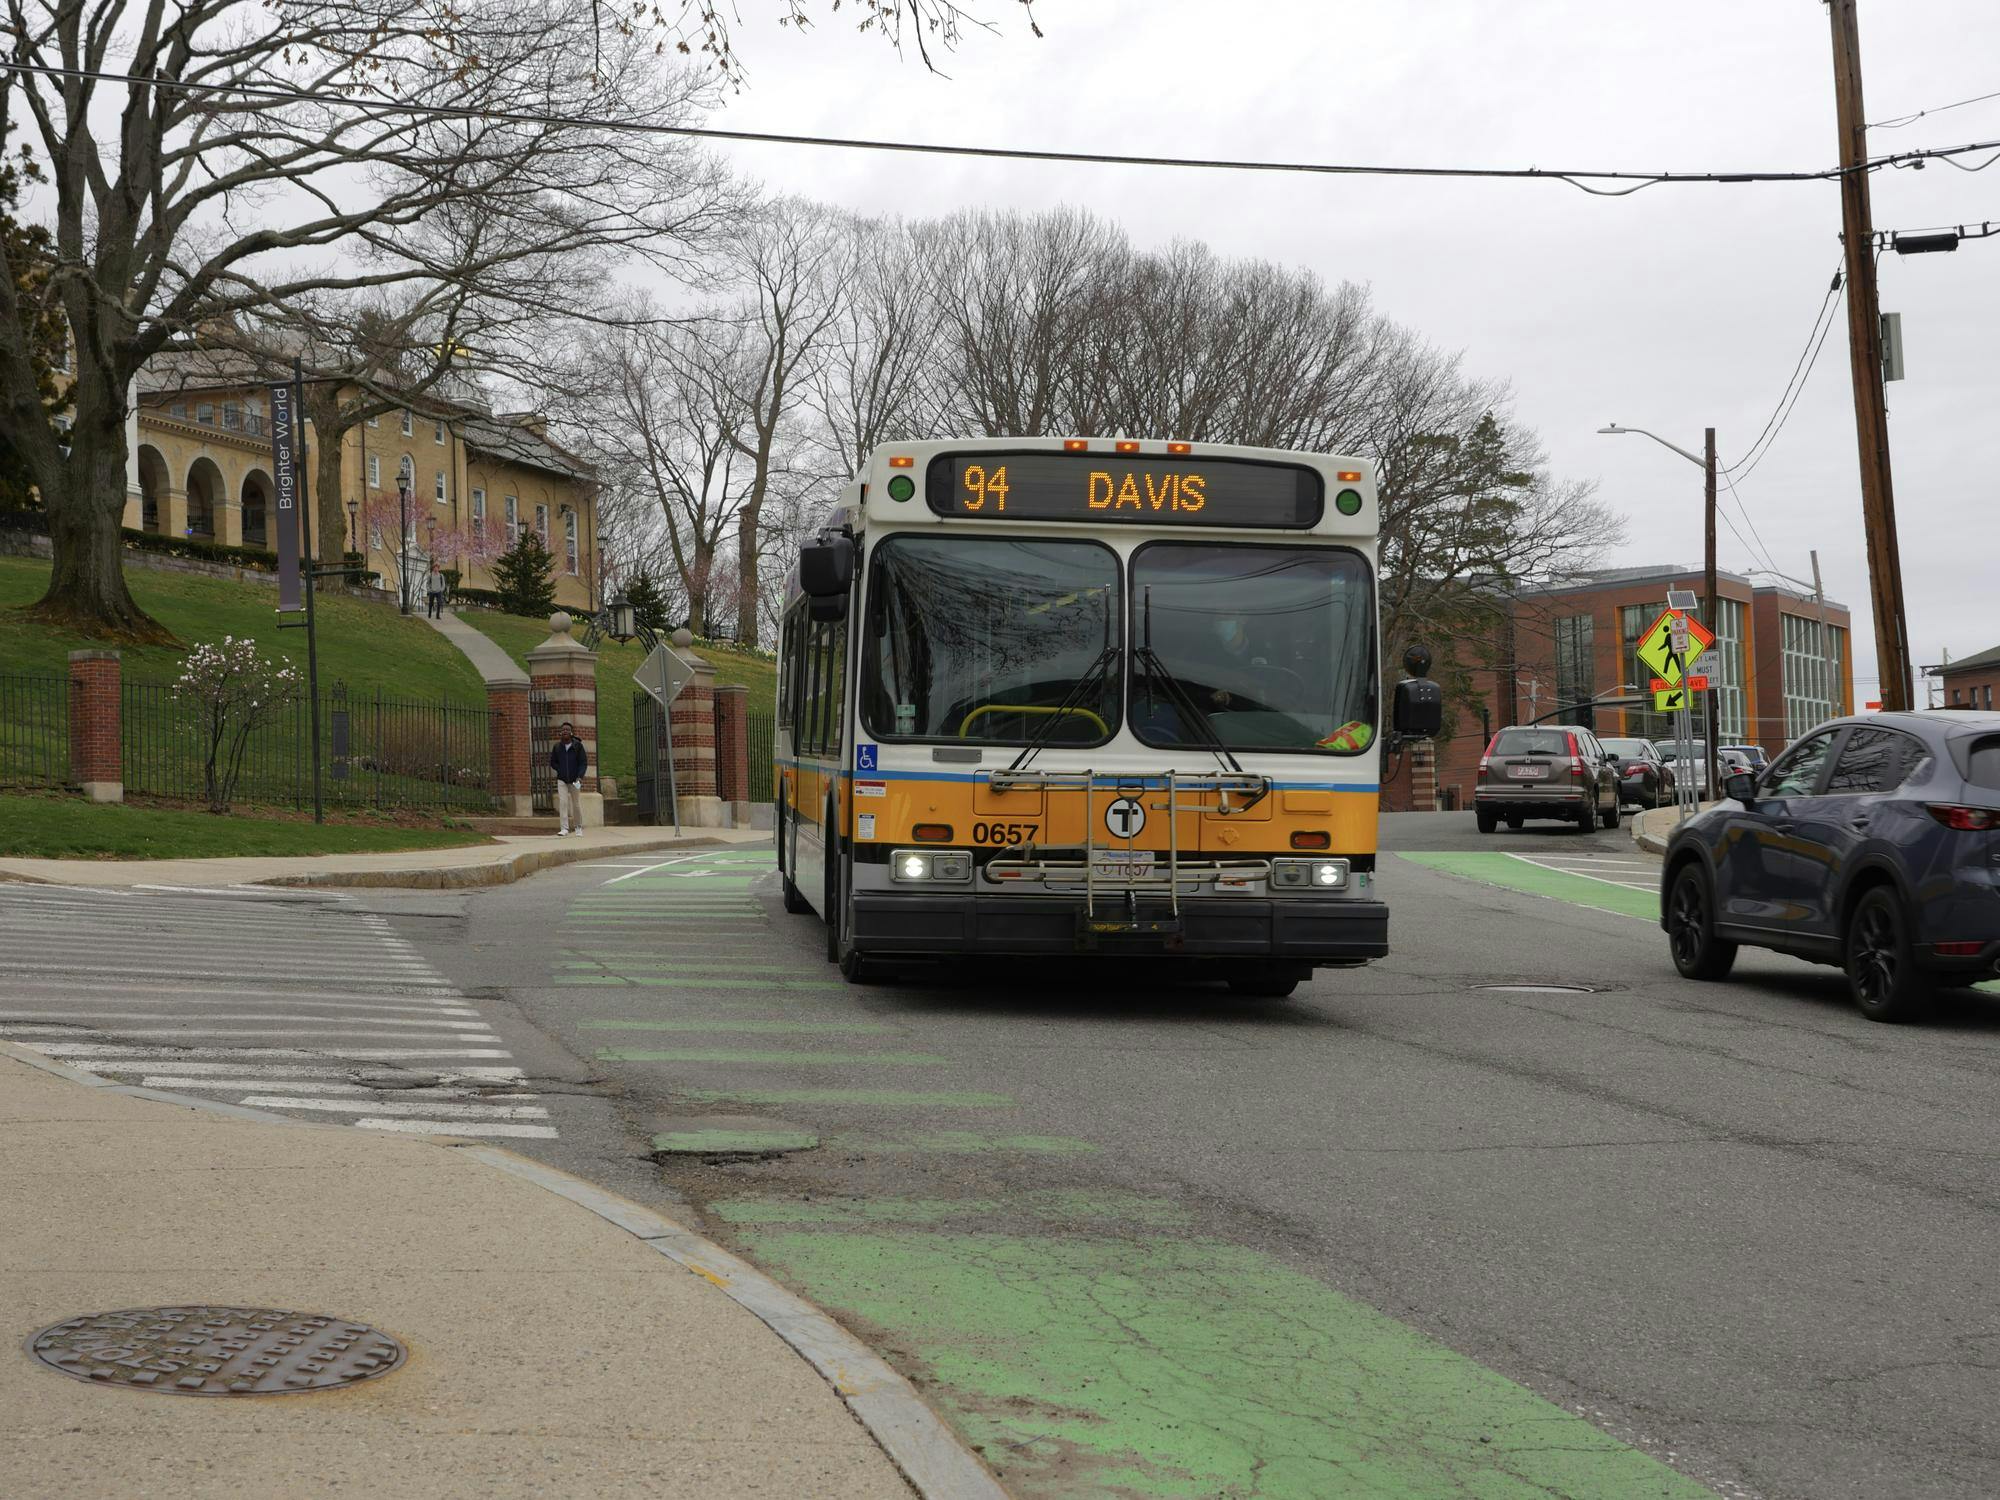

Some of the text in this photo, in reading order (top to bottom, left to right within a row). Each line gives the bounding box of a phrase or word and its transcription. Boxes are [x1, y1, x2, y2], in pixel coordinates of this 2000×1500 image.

[274, 388, 293, 509] Brighter World
[963, 465, 1206, 512] 94 DAVIS
[1696, 666, 1712, 674] MUST
[1690, 680, 1703, 688] AVE
[1112, 808, 1139, 833] T
[972, 822, 1039, 845] 0657
